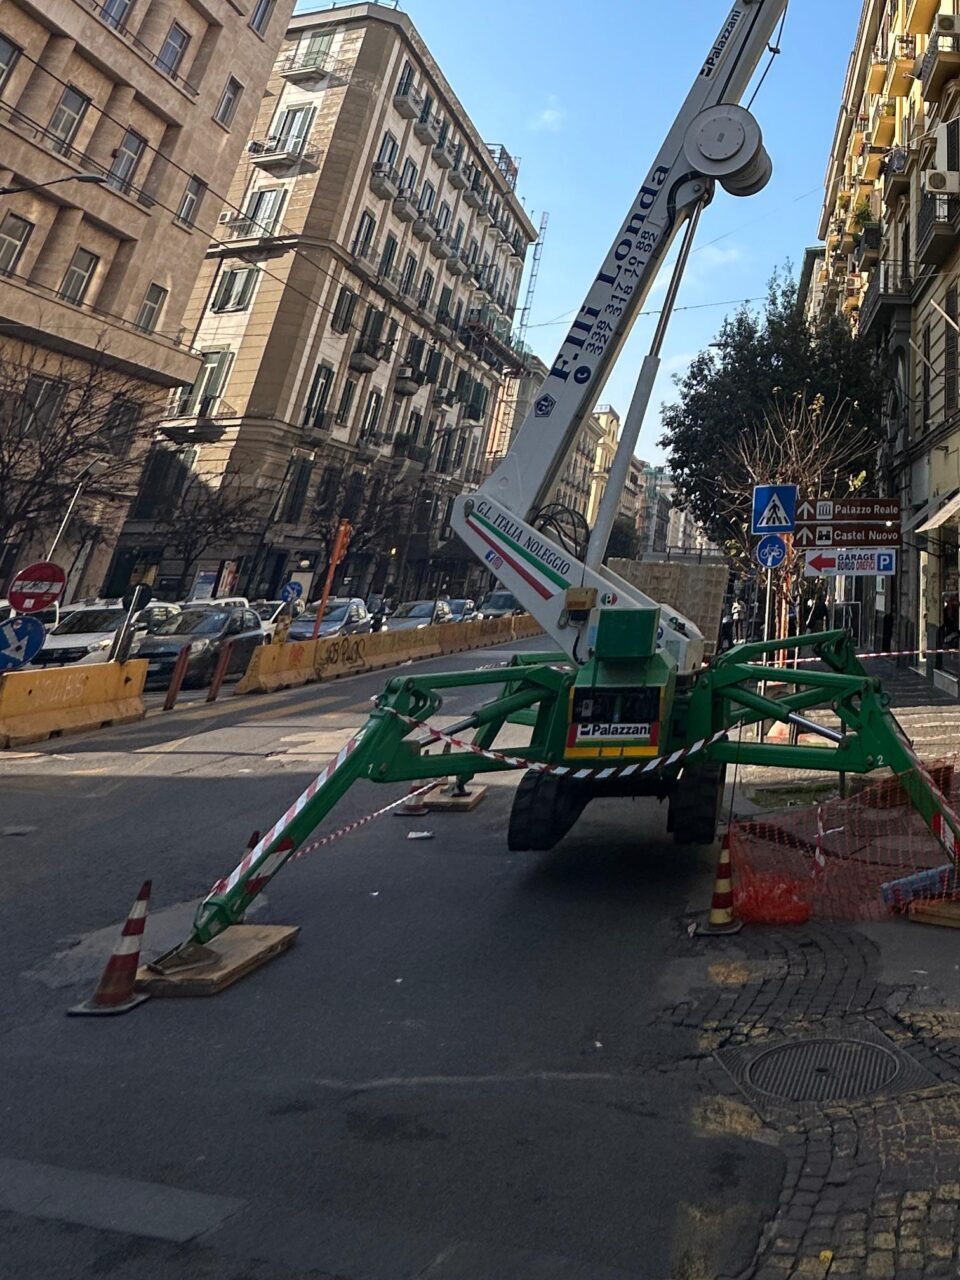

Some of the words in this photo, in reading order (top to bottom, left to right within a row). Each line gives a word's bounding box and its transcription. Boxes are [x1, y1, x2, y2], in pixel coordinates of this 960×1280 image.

[705, 9, 741, 67] Palazzani
[597, 165, 670, 287] Londa
[585, 320, 607, 354] 338
[605, 282, 623, 315] 317
[624, 256, 638, 277] 10
[635, 230, 650, 251] 88
[594, 322, 613, 356] 327
[613, 285, 633, 317] 318
[630, 260, 645, 278] 71
[643, 233, 659, 253] 92
[834, 504, 871, 514] Palazzo
[874, 504, 899, 514] Reale
[476, 501, 491, 520] G.L.
[493, 513, 524, 543] ITALIA
[523, 536, 571, 575] NOLEGGIO
[834, 530, 865, 540] Castel
[869, 530, 898, 540] Nuovo
[837, 553, 875, 561] GARAGE
[880, 555, 890, 570] P
[837, 560, 855, 570] BORGO
[856, 560, 875, 570] OREFICI
[592, 724, 651, 736] Palazzani
[876, 754, 884, 765] 2
